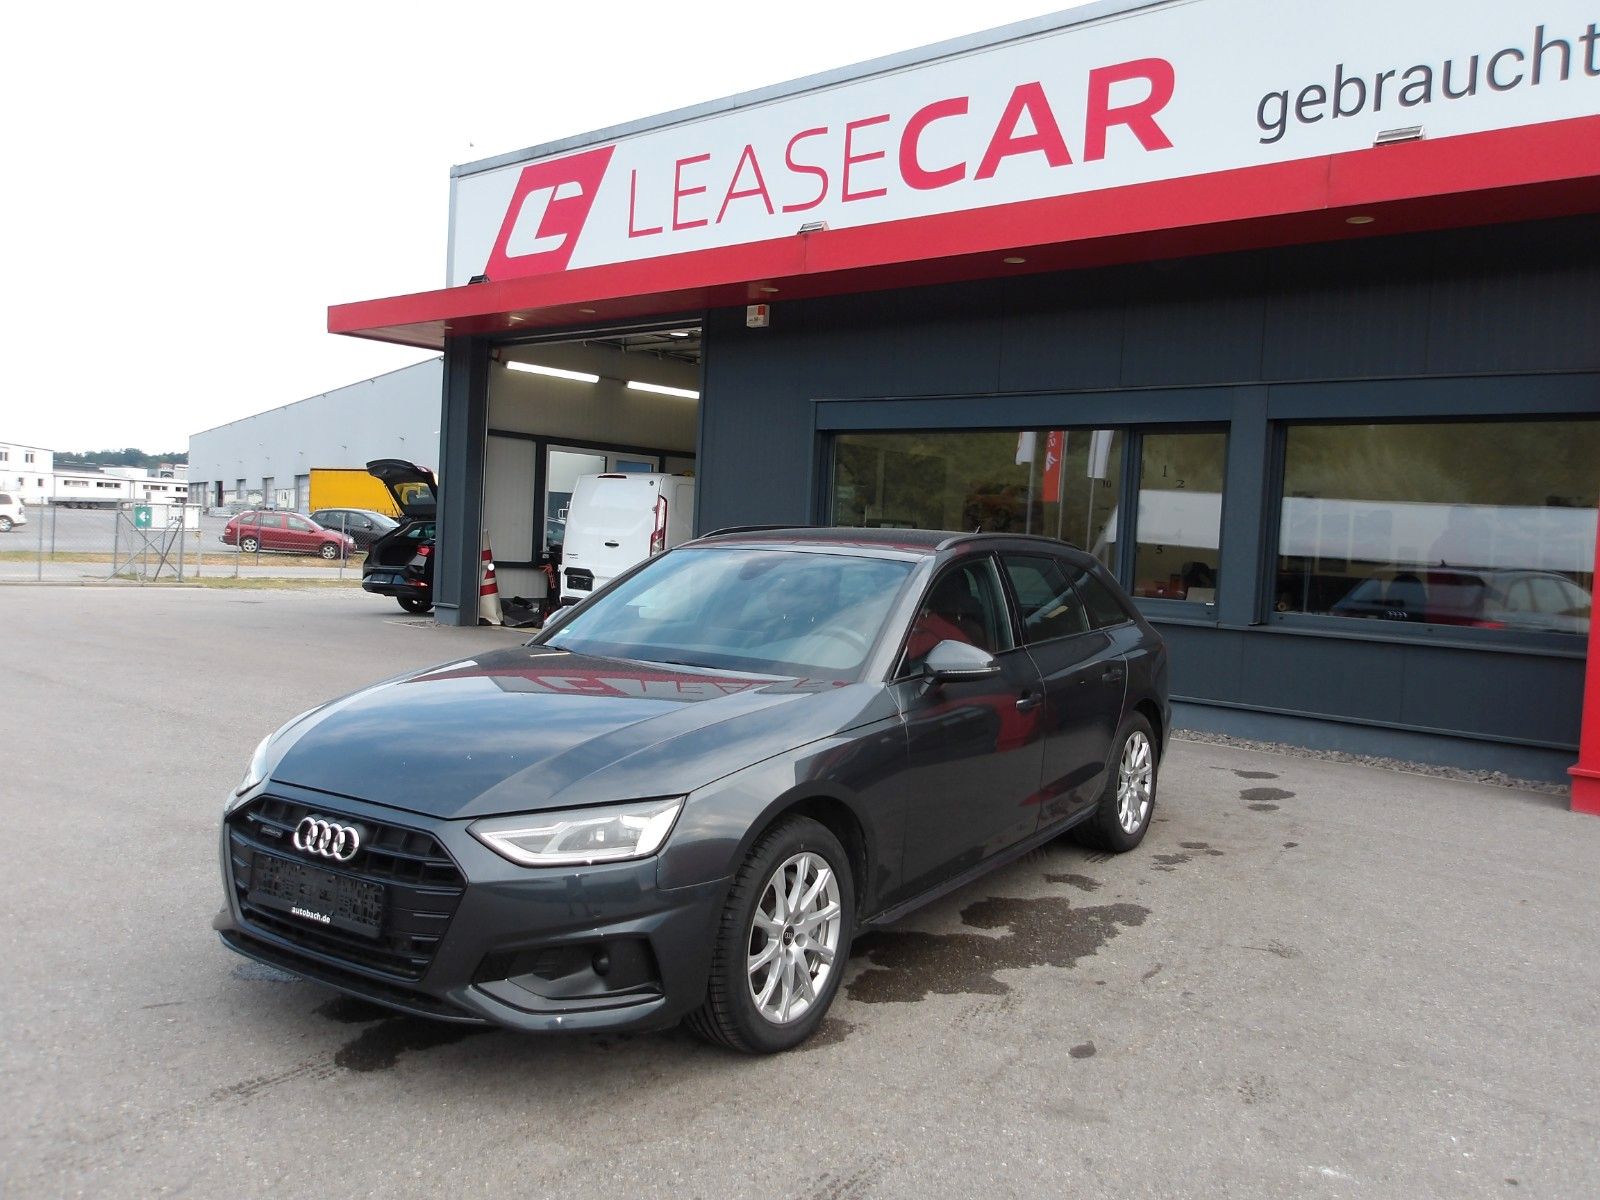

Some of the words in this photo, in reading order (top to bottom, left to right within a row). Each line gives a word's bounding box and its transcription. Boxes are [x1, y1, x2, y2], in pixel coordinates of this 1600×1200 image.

[1256, 24, 1600, 144] gebraucht
[628, 57, 1175, 238] LEASECAR
[291, 906, 331, 924] autobach.de
